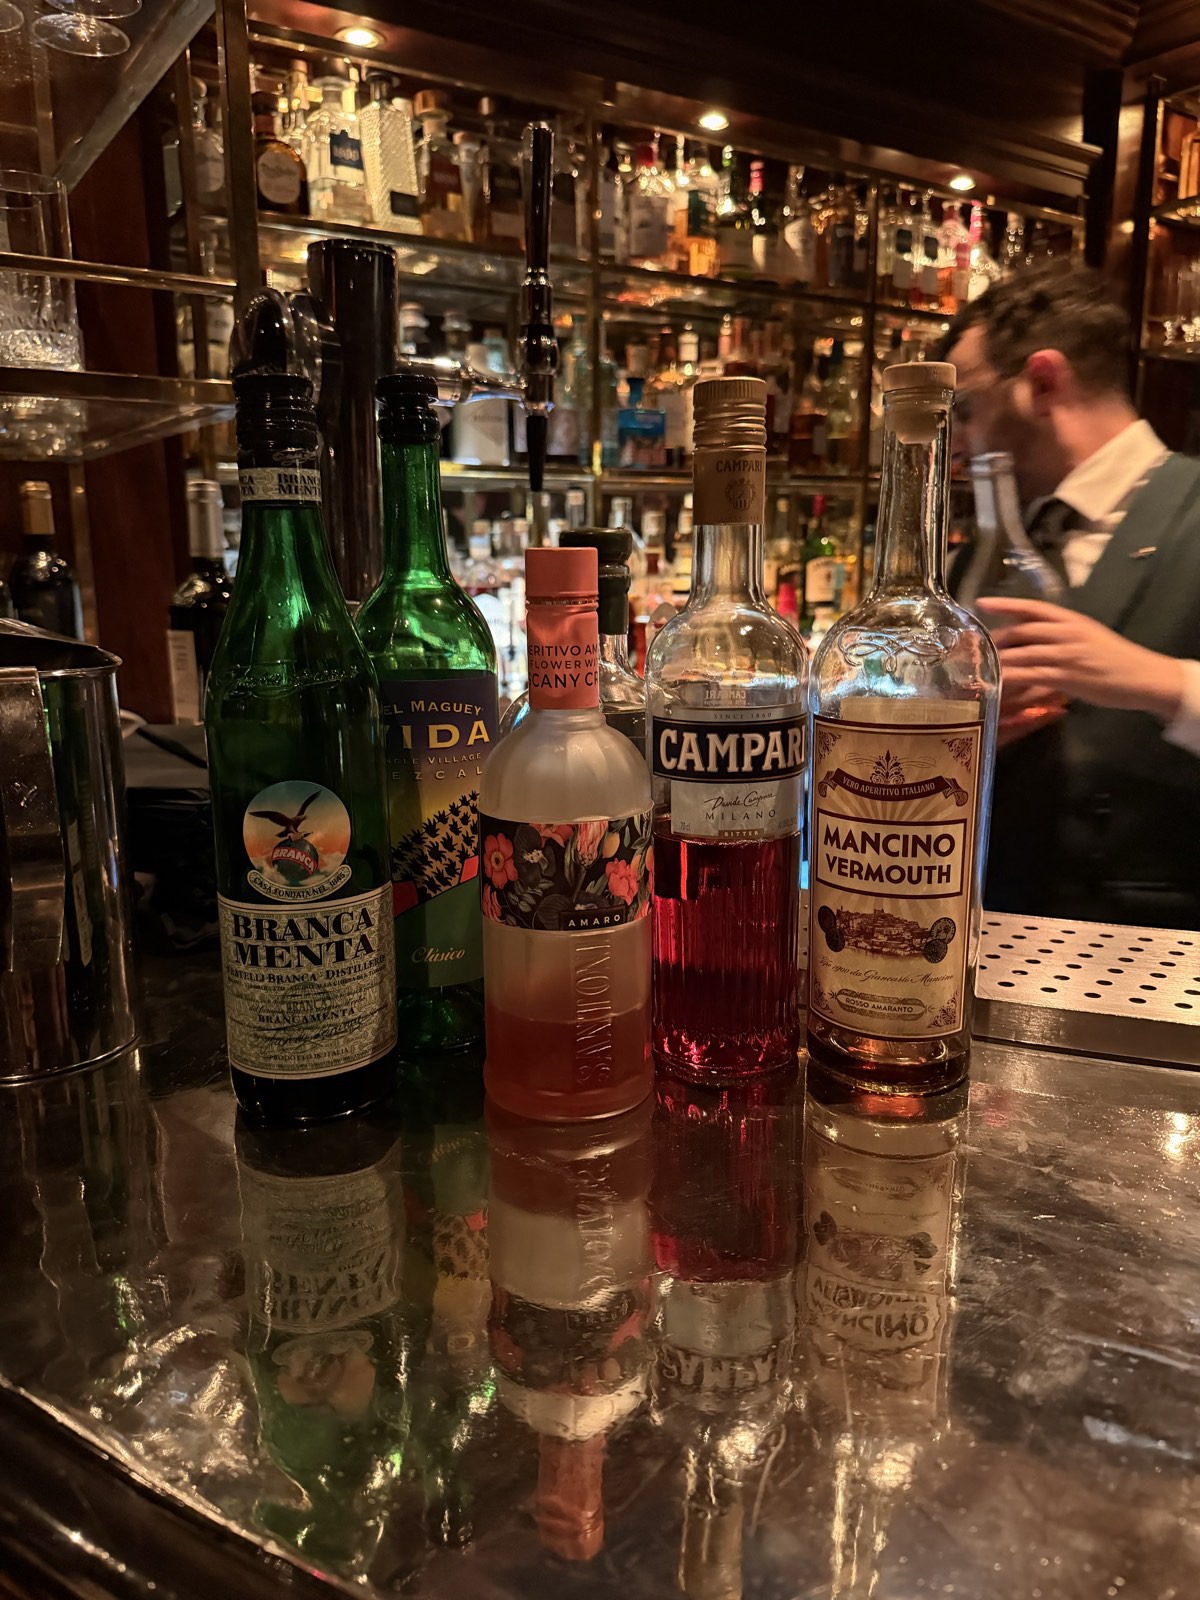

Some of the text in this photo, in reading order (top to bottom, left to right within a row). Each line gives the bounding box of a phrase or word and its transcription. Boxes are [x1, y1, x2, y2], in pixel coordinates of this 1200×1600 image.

[715, 460, 762, 472] CAMPARI
[584, 658, 598, 668] WI
[410, 700, 482, 716] MAGUEY
[751, 712, 773, 720] 1860
[659, 725, 806, 773] CAMPARI
[428, 753, 482, 765] VILLAGE
[842, 776, 936, 796] VERO APERITIVO ITALIANO
[705, 809, 776, 821] MILANO
[724, 830, 760, 838] BITTER
[824, 823, 956, 859] MANCINO
[273, 848, 315, 872] BRANCA
[825, 853, 951, 886] VERMOUTH
[253, 876, 272, 893] CASA
[273, 887, 311, 898] FONDATA
[329, 872, 346, 888] 1845
[232, 907, 374, 941] BRANCA
[568, 914, 621, 928] AMARO
[234, 933, 376, 968] MENTA
[268, 973, 318, 985] BRANCA
[845, 998, 914, 1013] ROSSO AMARANTO
[258, 1007, 357, 1024] BRANCAMENTA
